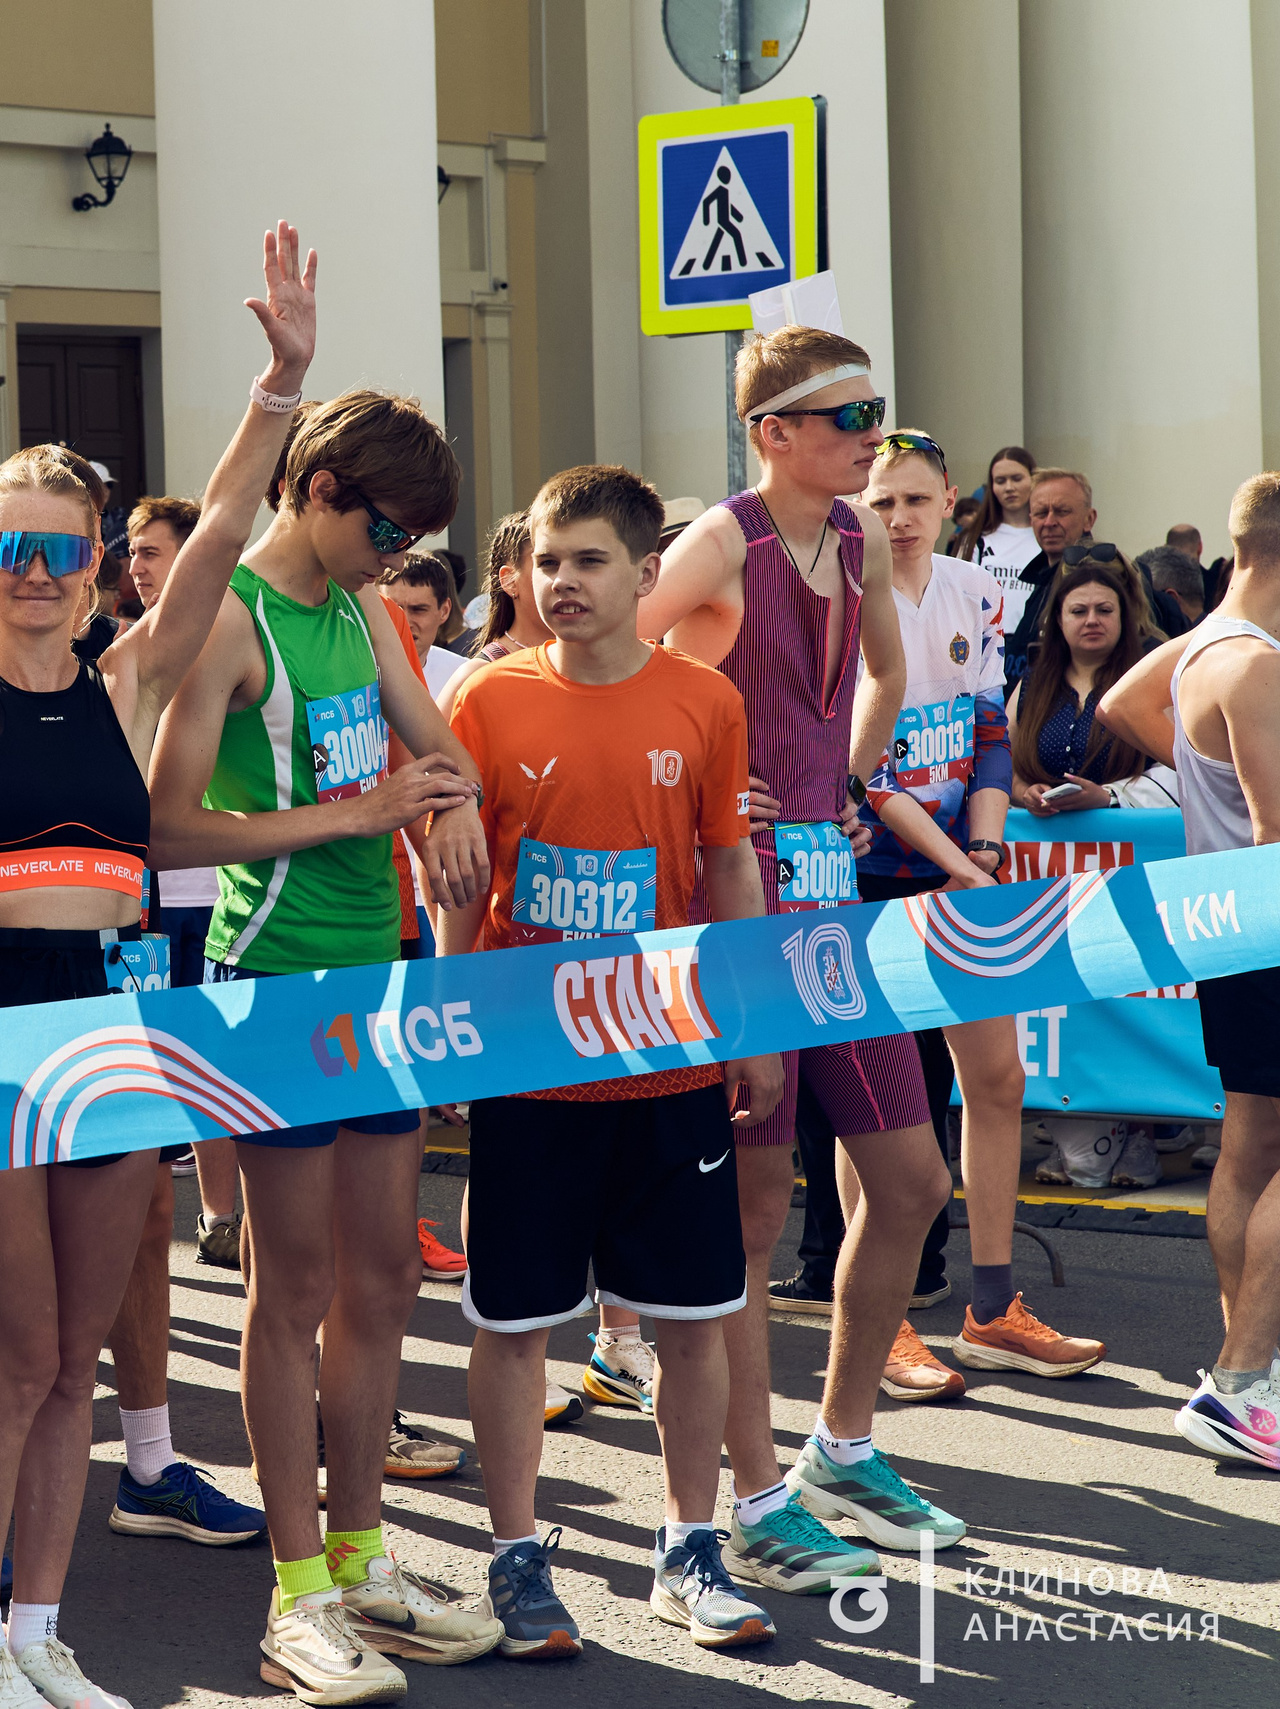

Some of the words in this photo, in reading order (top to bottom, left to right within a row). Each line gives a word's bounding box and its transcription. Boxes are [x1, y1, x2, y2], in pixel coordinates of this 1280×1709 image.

[321, 710, 335, 720] ПСБ
[351, 693, 366, 718] 10
[324, 714, 385, 784] 30004
[907, 720, 964, 768] 30013
[646, 749, 683, 787] 10
[0, 860, 84, 878] NEVERLATE
[532, 852, 547, 864] ПСБ
[574, 854, 598, 876] 10
[792, 850, 851, 898] 30012
[530, 873, 637, 930] 30312
[1155, 900, 1175, 945] 1
[781, 922, 867, 1026] 10
[553, 946, 716, 1058] СТАРТ
[366, 1000, 484, 1068] ПСБ
